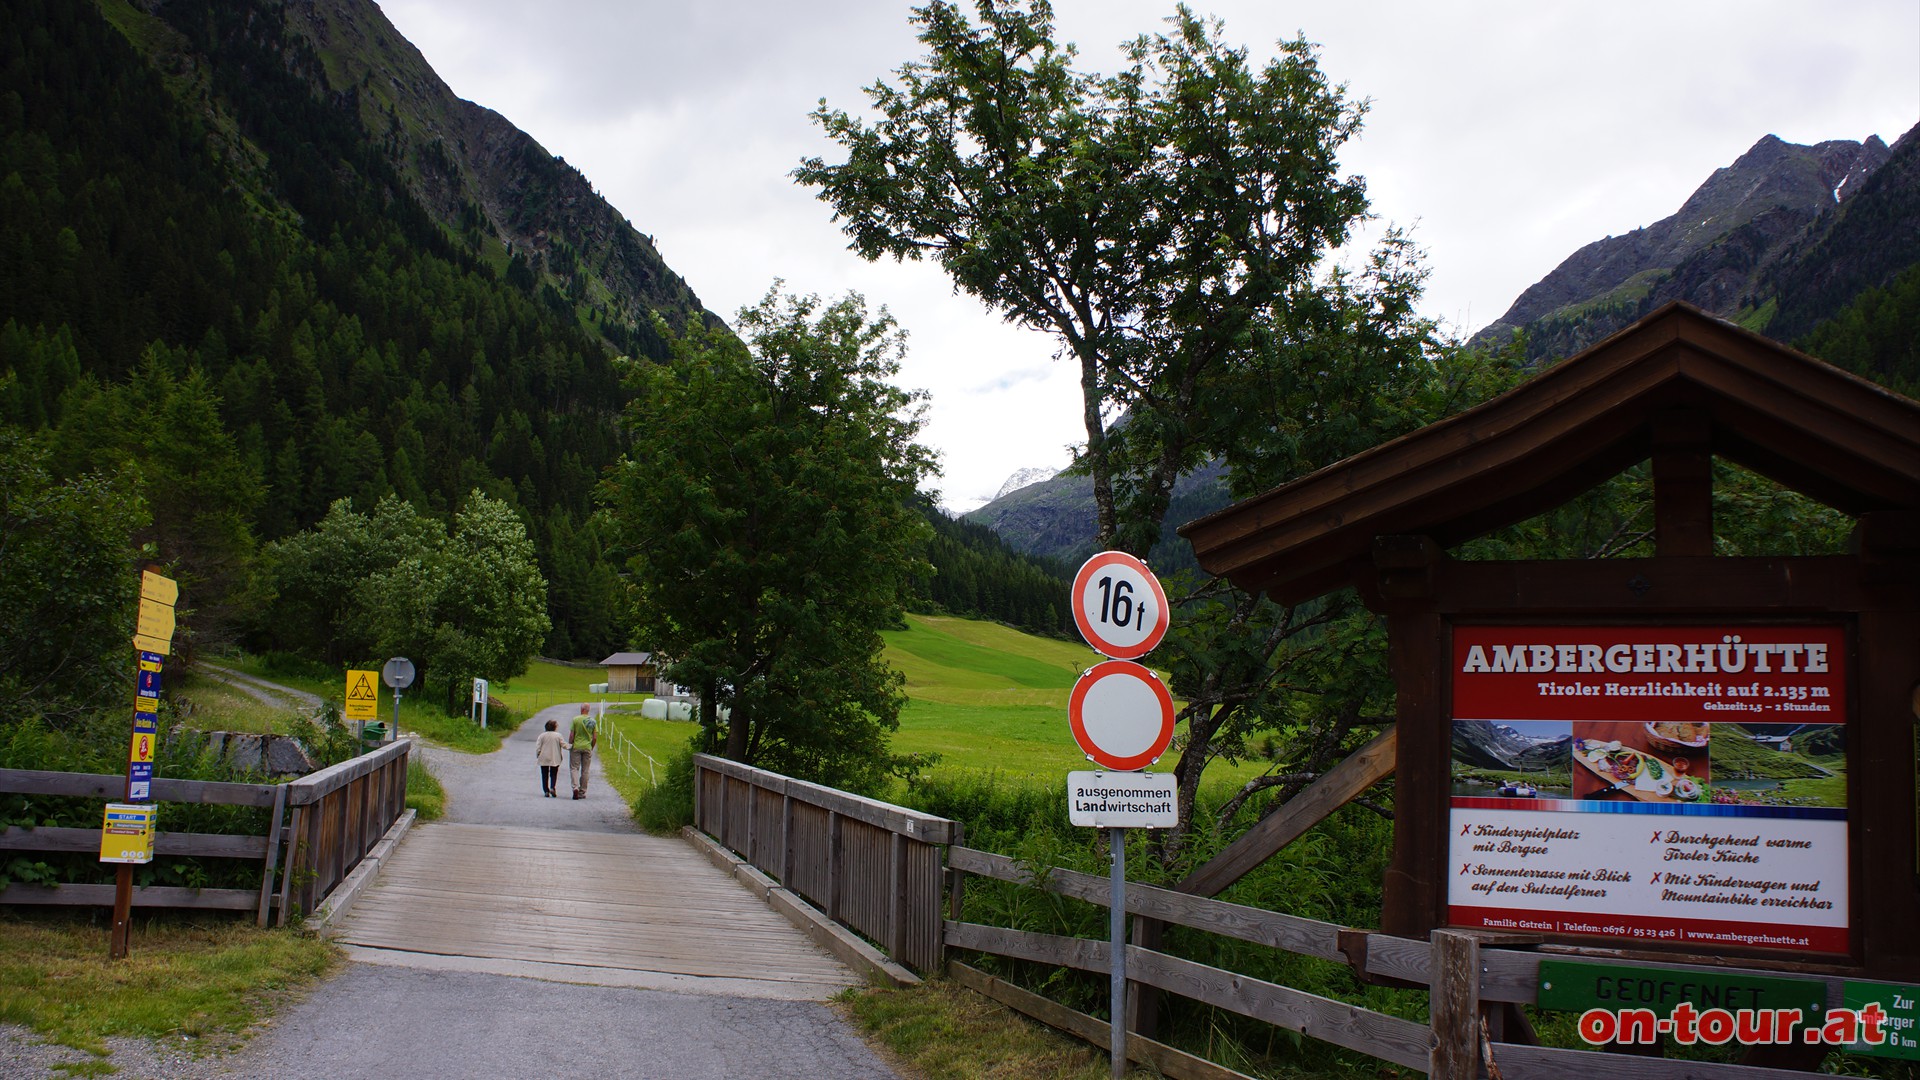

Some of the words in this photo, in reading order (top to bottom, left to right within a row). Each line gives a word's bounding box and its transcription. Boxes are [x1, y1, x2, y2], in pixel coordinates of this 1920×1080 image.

[1098, 576, 1134, 628] 16
[1137, 601, 1145, 632] t
[1462, 634, 1829, 673] AMBERGERHÜTTE
[1538, 682, 1600, 695] Tiroler
[1605, 682, 1721, 696] Herzlichkeit
[1727, 683, 1759, 696] auf
[1764, 687, 1807, 700] 2.135
[1811, 687, 1830, 697] m
[1704, 702, 1747, 710] Gehzeit:
[1749, 704, 1762, 712] 1,5
[1783, 703, 1830, 711] Stunden
[1077, 787, 1171, 801] ausgenommen
[1076, 800, 1171, 813] Landwirtschaft
[1473, 825, 1581, 842] Kinderspielplatz
[1664, 830, 1760, 849] Durchgehend
[1766, 840, 1811, 848] warme
[1473, 842, 1495, 852] mit
[1497, 840, 1548, 857] Bergsee
[1664, 847, 1711, 861] Tiroler
[1712, 850, 1759, 863] Küche
[1473, 864, 1565, 879] Sonnenterrasse
[1568, 870, 1591, 880] mit
[1592, 869, 1631, 882] Blick
[1472, 881, 1496, 895] auf
[1496, 881, 1518, 892] den
[1522, 882, 1607, 899] Sulztalferner
[1665, 873, 1691, 885] Mit
[1693, 873, 1787, 893] Kinderwagen
[1791, 881, 1820, 891] und
[1662, 889, 1757, 905] Mountainbike
[1761, 896, 1832, 909] erreichbar
[1484, 918, 1517, 927] Familie
[1519, 920, 1552, 929] Gstrein
[1564, 922, 1601, 933] Telefon:
[1603, 926, 1625, 935] 0676
[1659, 929, 1675, 937] 426
[1687, 932, 1809, 945] www.ambergerhuette.at
[1893, 995, 1914, 1009] Zur
[1890, 1032, 1898, 1045] 6
[1902, 1037, 1916, 1047] km
